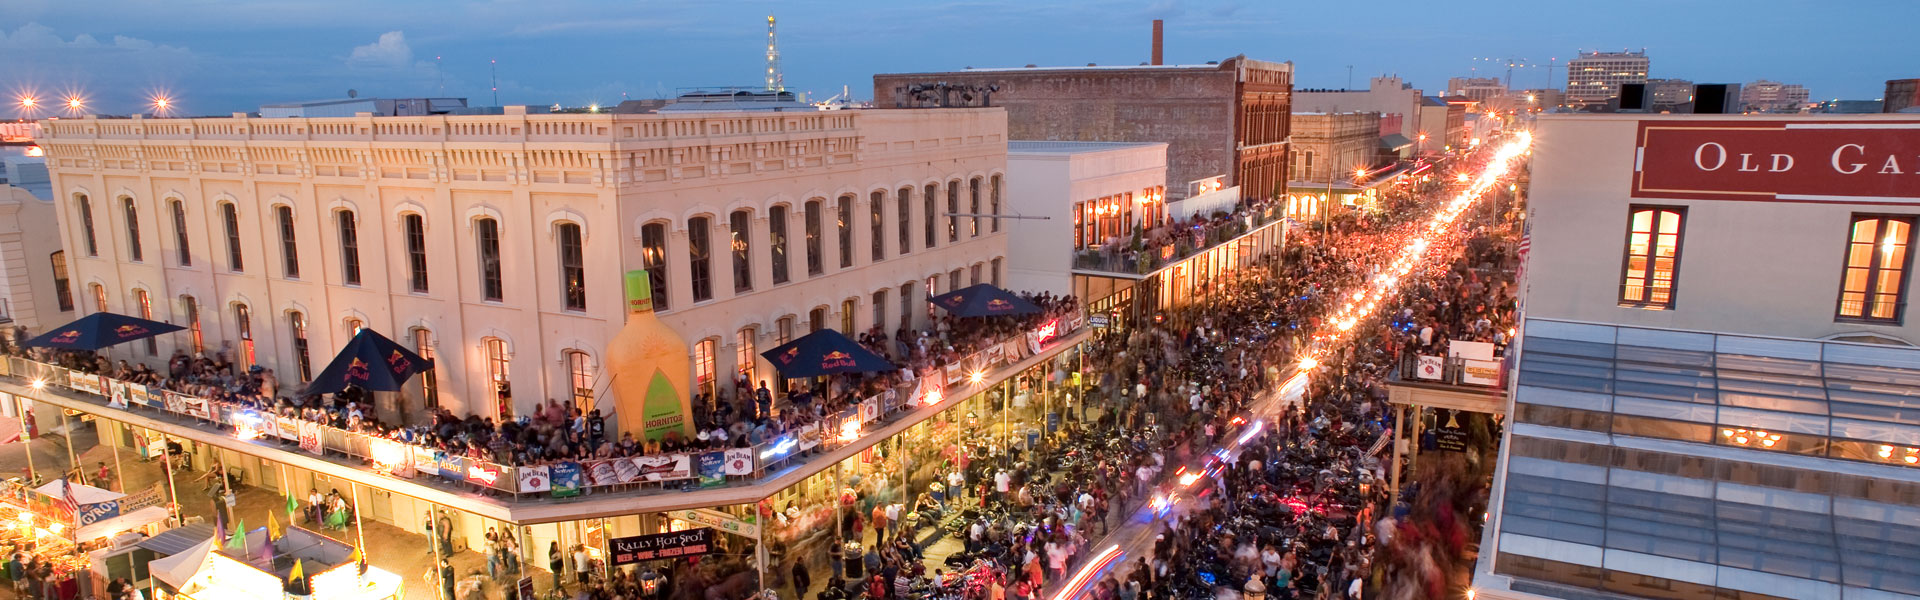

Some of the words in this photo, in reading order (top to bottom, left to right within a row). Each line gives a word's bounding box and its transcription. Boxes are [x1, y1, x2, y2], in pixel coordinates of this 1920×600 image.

[1694, 141, 1794, 172] OLD
[1831, 143, 1920, 175] GA
[821, 360, 840, 369] Red
[841, 359, 856, 367] Bull
[645, 414, 683, 429] HORNITOS
[302, 433, 317, 446] red
[726, 453, 736, 464] JIM
[736, 451, 751, 461] BEAM
[440, 459, 463, 473] ALEVE
[521, 471, 532, 482] JIM
[532, 468, 548, 479] BEAM
[126, 494, 160, 509] ITALIAN
[81, 499, 118, 525] GYROS
[617, 540, 652, 552] RALLY
[656, 535, 678, 548] HOT
[680, 531, 705, 547] SPOT
